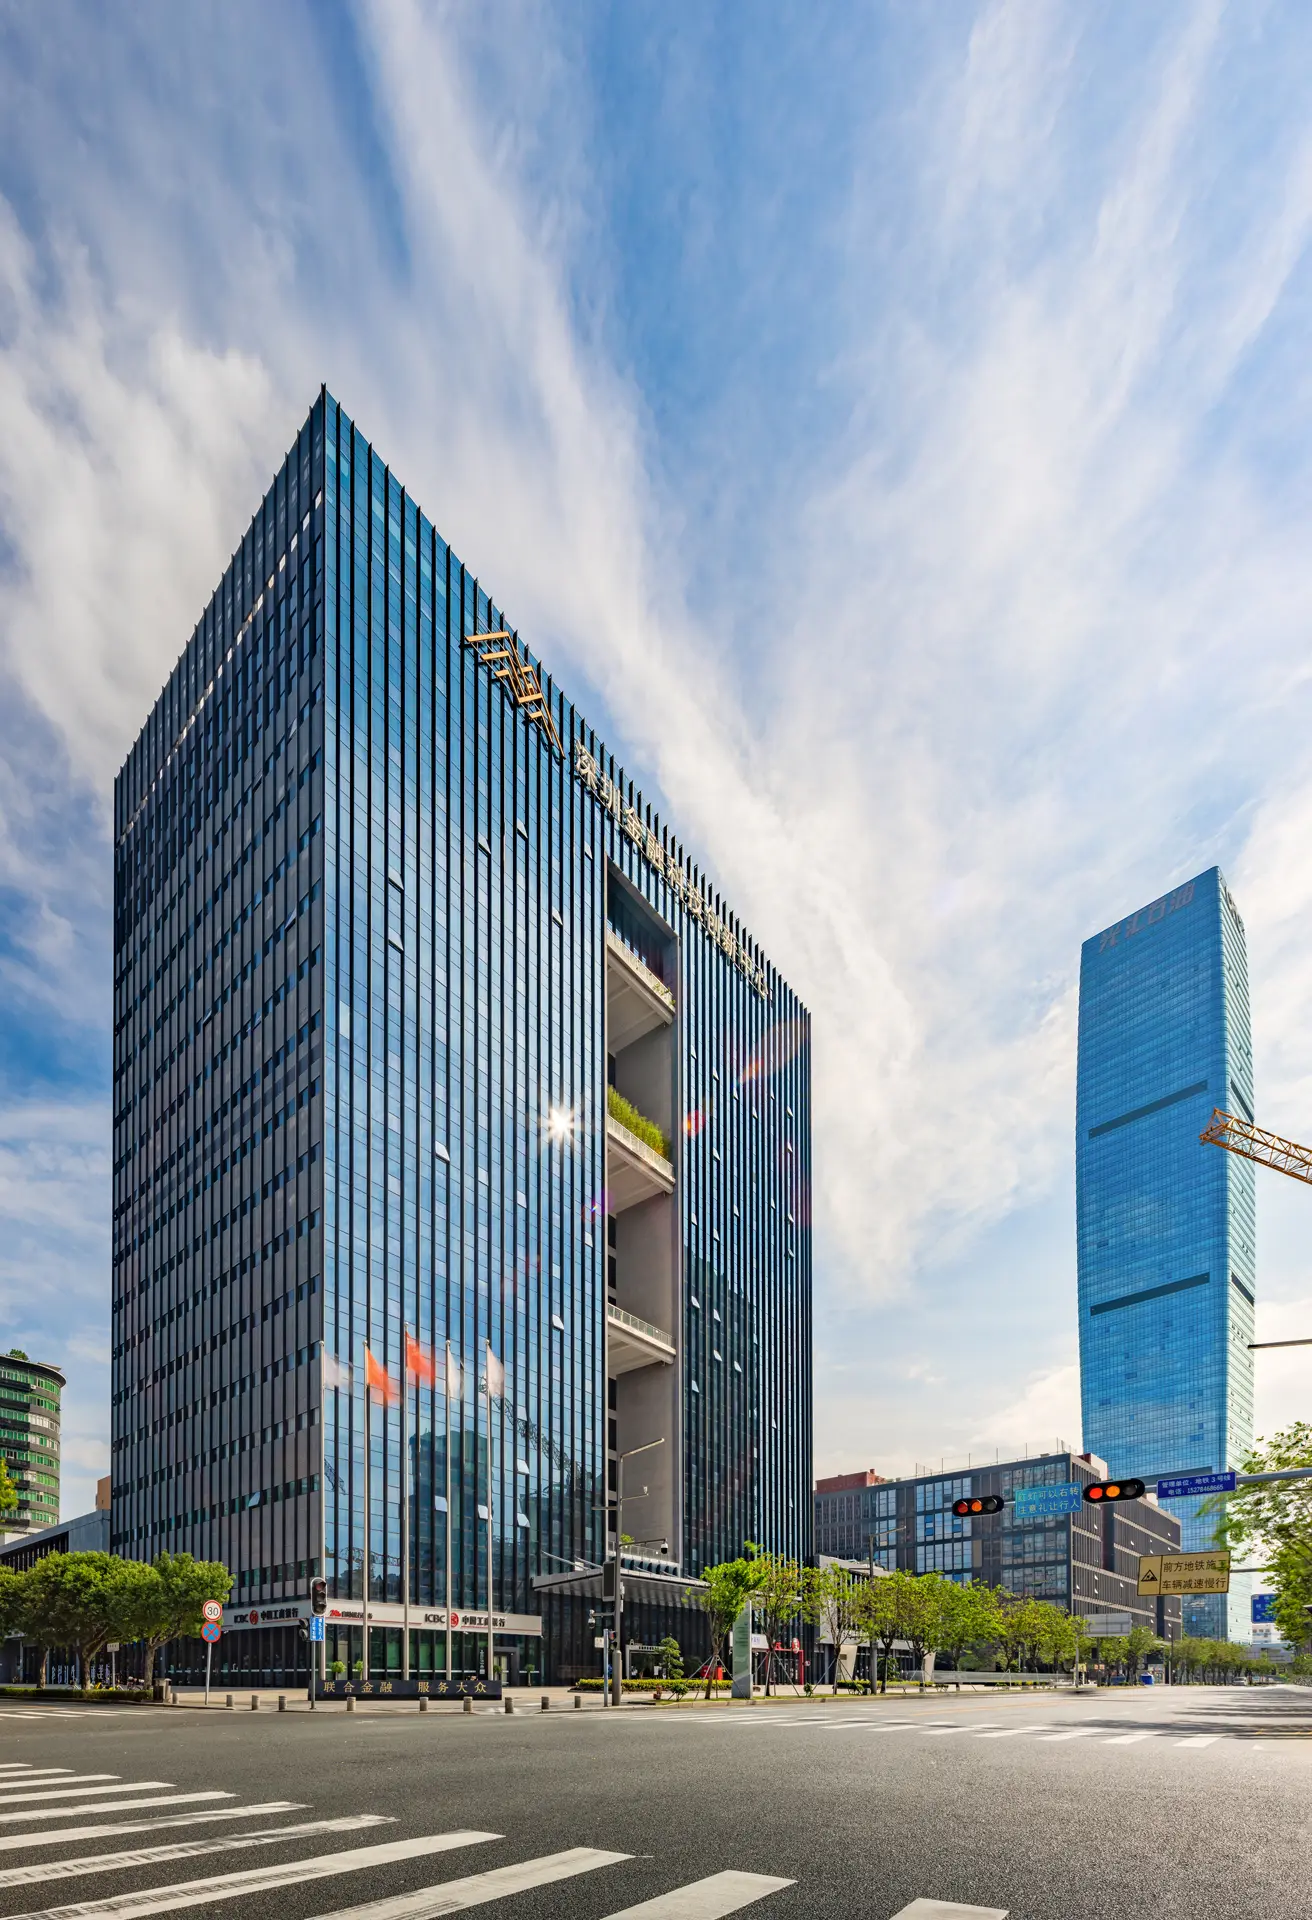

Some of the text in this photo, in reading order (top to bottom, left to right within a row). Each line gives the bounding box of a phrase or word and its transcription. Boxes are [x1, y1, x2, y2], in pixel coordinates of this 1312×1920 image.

[574, 739, 769, 999] 深圳金融科技创新中心
[1018, 1486, 1079, 1502] 红灯可以右转
[1018, 1499, 1079, 1514] 注意礼让行人
[1162, 1577, 1226, 1590] 车辆减速慢行
[207, 1606, 218, 1616] 30
[425, 1613, 445, 1623] ICBC
[323, 1681, 487, 1693] 联合金融 服务大众
